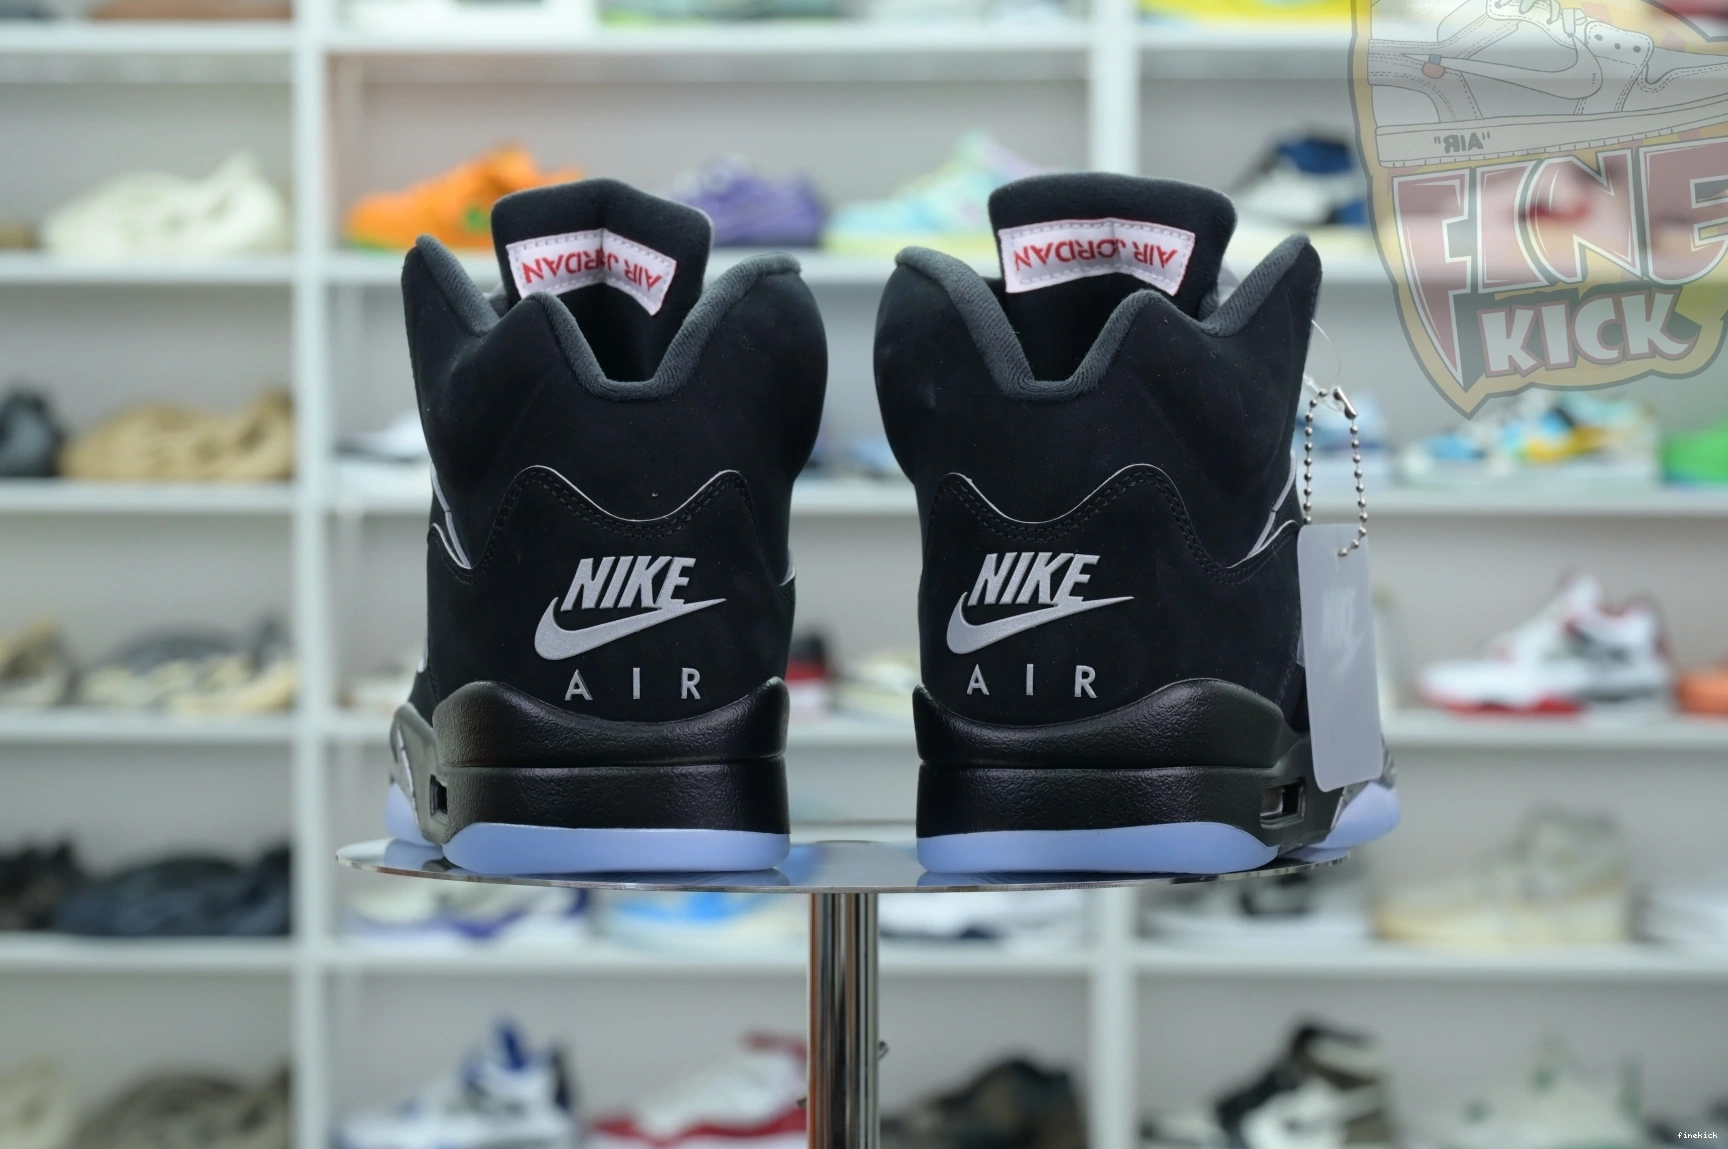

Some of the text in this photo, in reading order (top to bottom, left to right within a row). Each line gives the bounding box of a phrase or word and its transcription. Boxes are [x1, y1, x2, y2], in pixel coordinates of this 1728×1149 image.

[624, 259, 663, 290] AIR
[1133, 241, 1178, 268] AIR
[560, 556, 696, 612] NIKE
[967, 552, 1100, 606] NIKE
